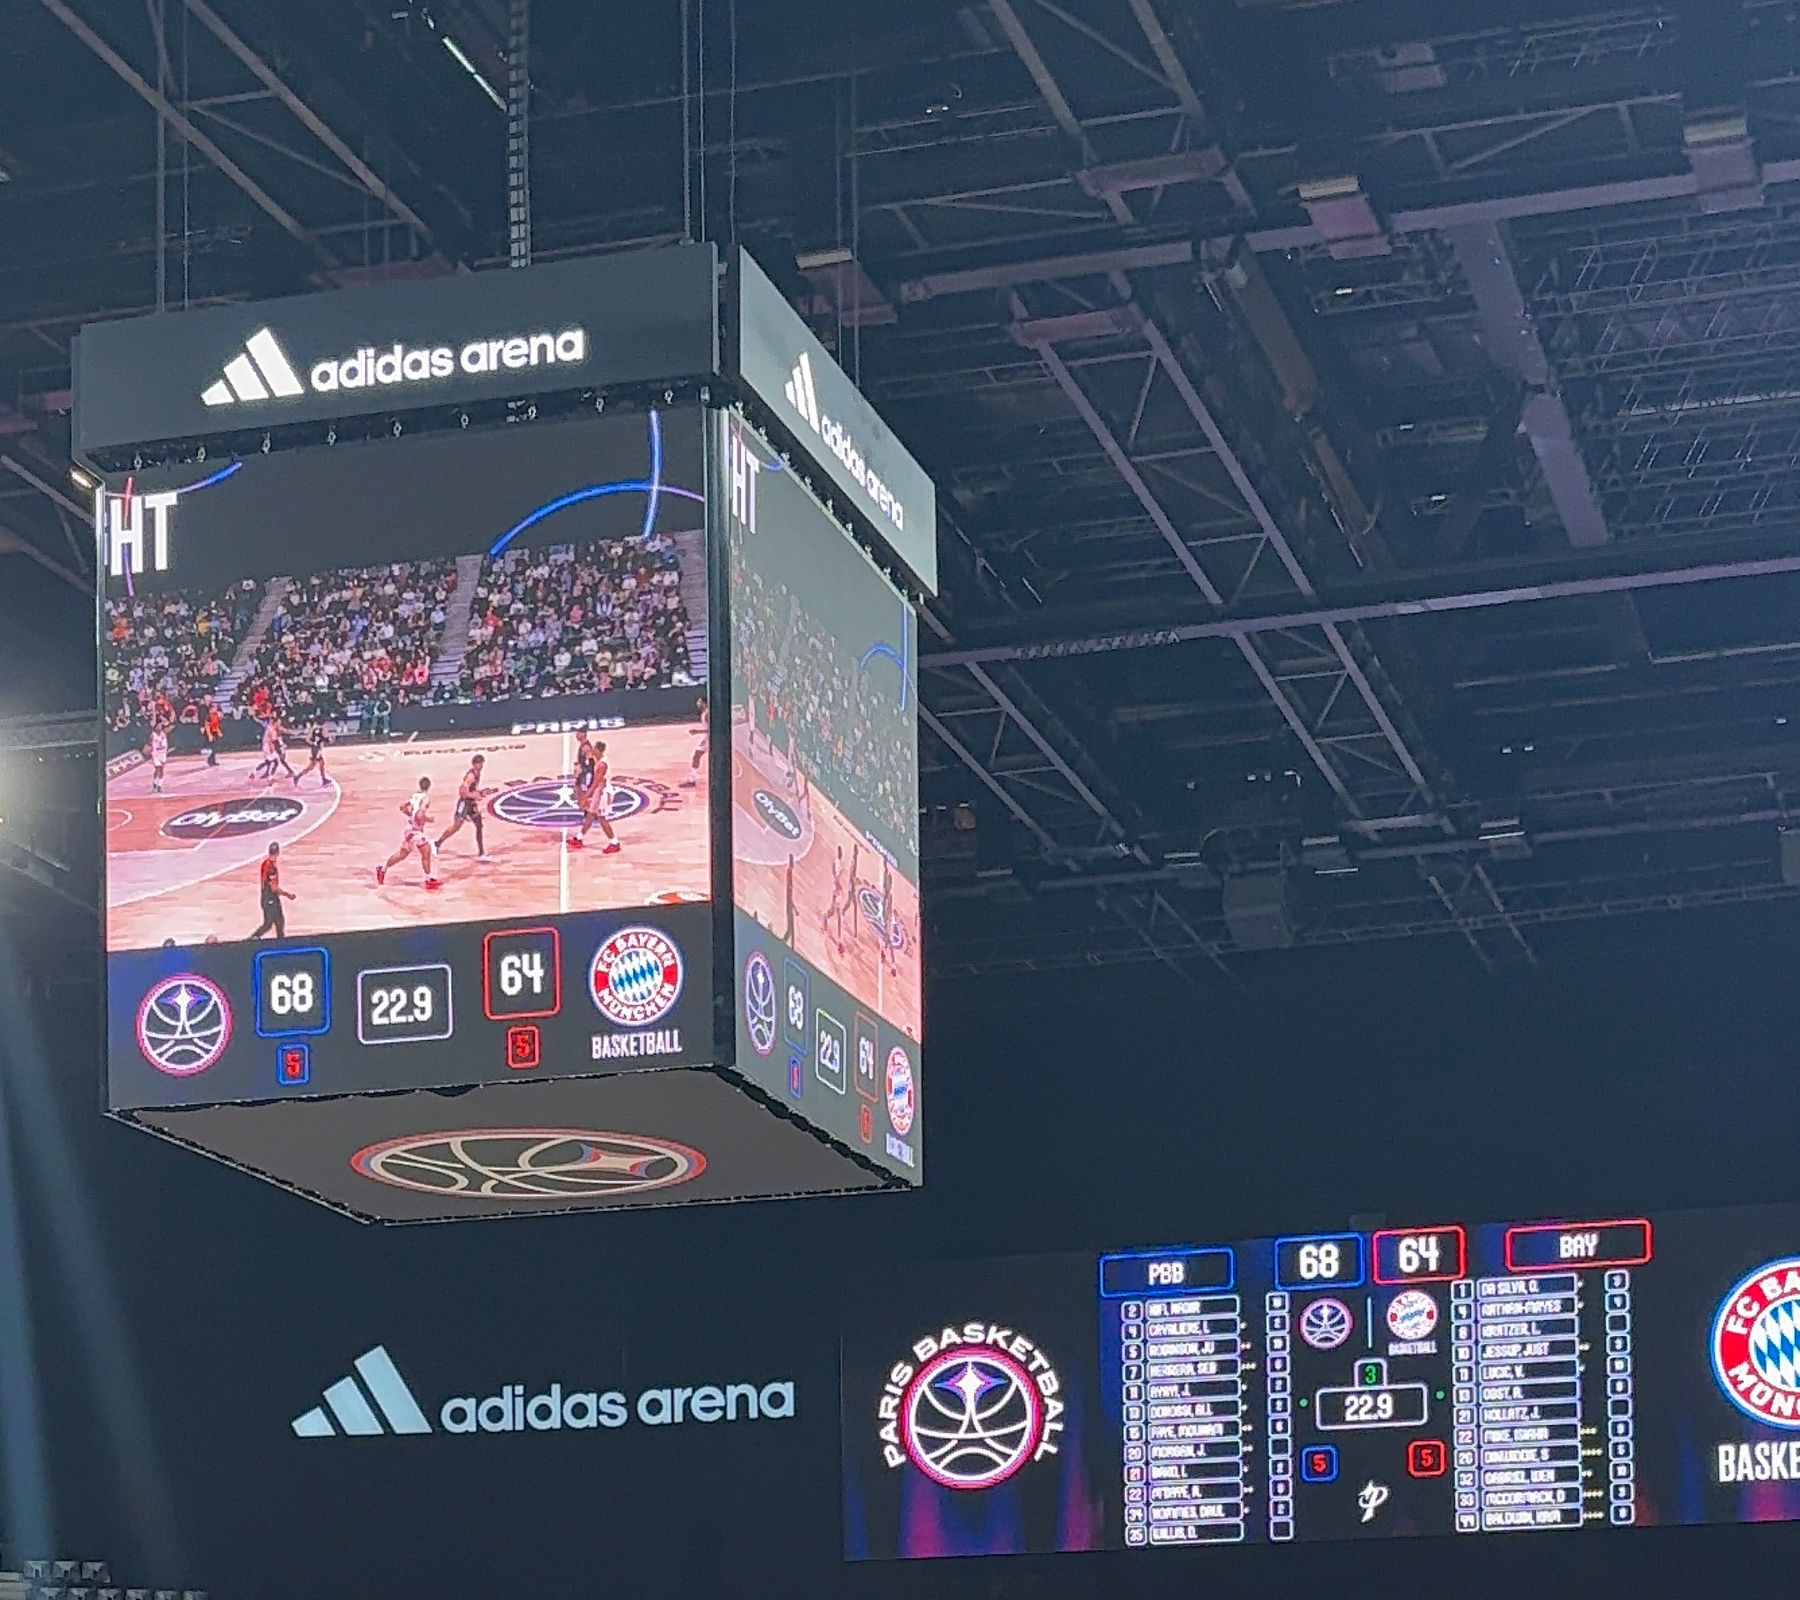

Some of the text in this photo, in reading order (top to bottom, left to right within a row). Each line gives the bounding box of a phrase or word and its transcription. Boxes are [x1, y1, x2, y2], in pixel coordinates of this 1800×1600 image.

[311, 330, 584, 391] adidas arena
[730, 435, 760, 534] HT
[822, 415, 903, 531] adidas arena
[104, 492, 177, 576] HT
[169, 808, 297, 829] OlyBet
[598, 950, 615, 972] FC
[615, 933, 674, 967] BAYERN
[501, 953, 544, 995] 64
[271, 973, 313, 1014] 68
[371, 986, 432, 1025] 22.9
[516, 1034, 530, 1057] 5
[592, 1029, 682, 1060] BASKETBALL
[286, 1053, 300, 1077] 5
[1399, 1236, 1440, 1273] 64
[1560, 1234, 1598, 1258] BAY
[1148, 1263, 1185, 1286] PBB
[1300, 1243, 1339, 1280] 68
[1726, 1271, 1800, 1335] FC BA
[1129, 1367, 1138, 1379] 7
[1365, 1366, 1376, 1383] 3
[879, 1324, 1063, 1468] PARIS BASKETBALL
[1728, 1362, 1800, 1417] MÜN
[442, 1382, 794, 1432] adidas arena
[1345, 1393, 1393, 1423] 22.9
[1459, 1412, 1471, 1423] 21
[1459, 1431, 1472, 1442] 22
[1313, 1453, 1327, 1472] 5
[1421, 1449, 1433, 1467] 5
[1129, 1489, 1142, 1500] 22
[1129, 1509, 1143, 1521] 34
